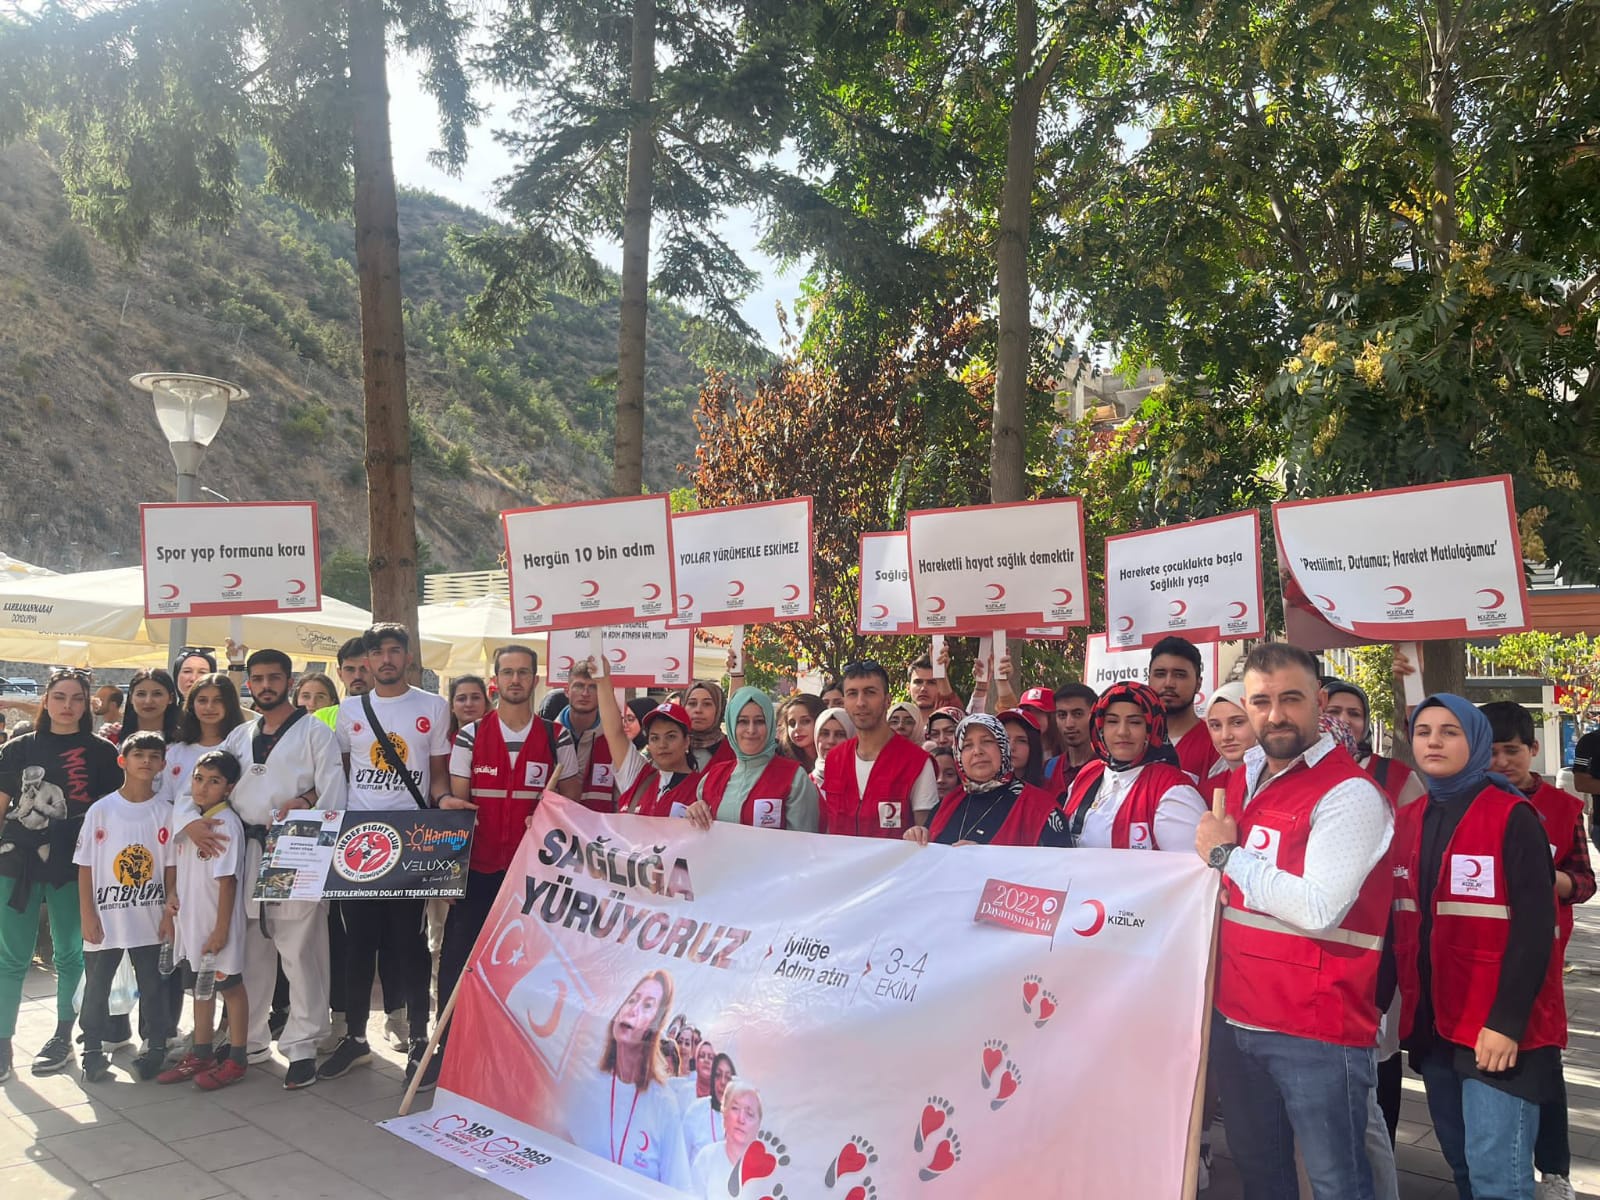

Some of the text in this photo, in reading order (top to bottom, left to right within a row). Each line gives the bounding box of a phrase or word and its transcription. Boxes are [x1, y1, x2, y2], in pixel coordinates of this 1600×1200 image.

[157, 543, 306, 563] Spor yap formunu koru
[523, 542, 655, 569] Hergün 10 bin adım
[680, 540, 799, 566] YOLLAR YÜRÜMEKLE ESKİMEZ
[919, 548, 1075, 574] Hareketli hayat sağlık demektir
[1119, 551, 1243, 581] Harekete çocuklukta başla
[1392, 549, 1429, 567] Hareket
[875, 569, 910, 582] Sağlığ
[1150, 573, 1210, 592] Sağlıklı yaşa
[1096, 665, 1139, 683] Hayata
[337, 824, 399, 851] HEDEF FIGHT CLUB
[424, 828, 470, 844] Harmony
[401, 858, 456, 872] VELUXX
[538, 828, 694, 902] SAĞLIĞA
[380, 889, 404, 897] DOLAYI
[404, 888, 438, 898] TEŞEKKÜR
[993, 885, 1040, 917] 2022
[521, 875, 752, 969] YÜRÜYORUZ
[980, 902, 1053, 932] Dayanışma Yılı
[1107, 915, 1146, 928] KIZILAY
[1118, 909, 1135, 918] TÜRK
[784, 932, 830, 962] İyiliğe
[774, 958, 850, 989] Adım atın
[885, 948, 928, 979] 3-4
[875, 977, 918, 1002] EKİM
